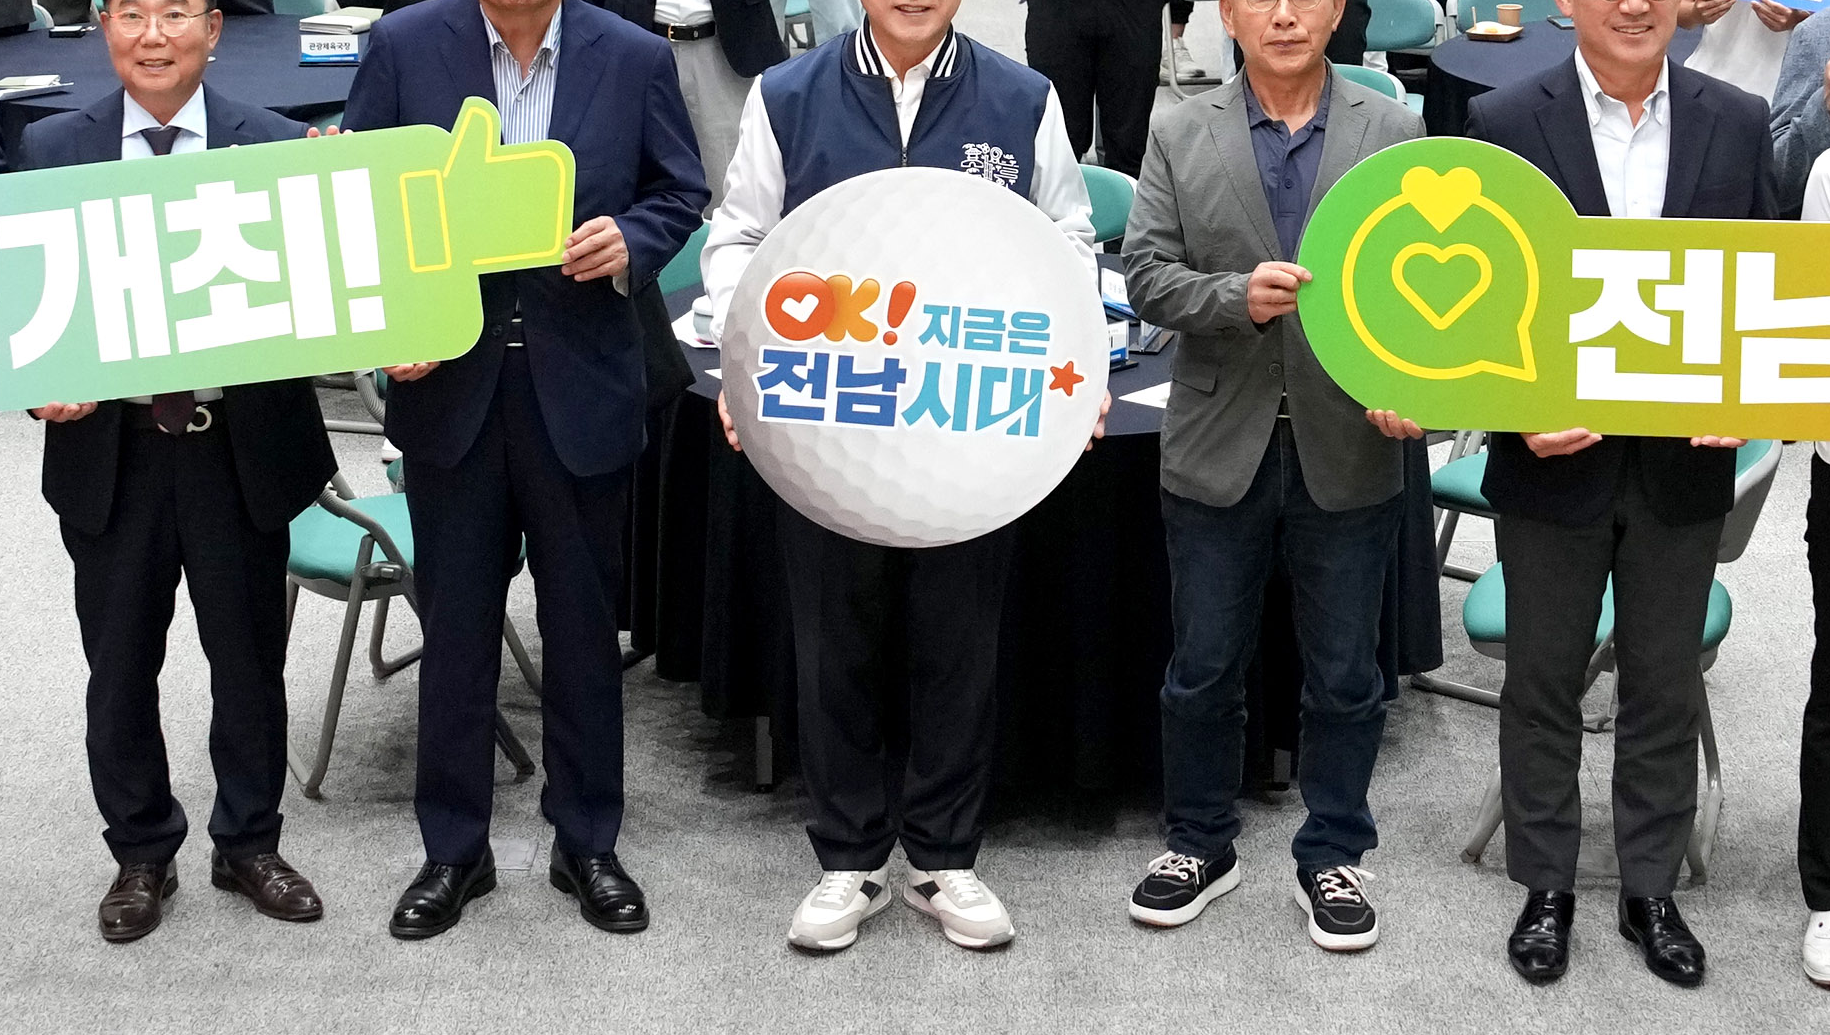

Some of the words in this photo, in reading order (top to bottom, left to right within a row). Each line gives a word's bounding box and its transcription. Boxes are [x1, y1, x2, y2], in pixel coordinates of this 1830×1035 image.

[309, 42, 350, 50] 관광체육국장
[765, 271, 917, 346] OK!
[917, 303, 1051, 355] 지금은
[757, 349, 1045, 437] 전남시대
